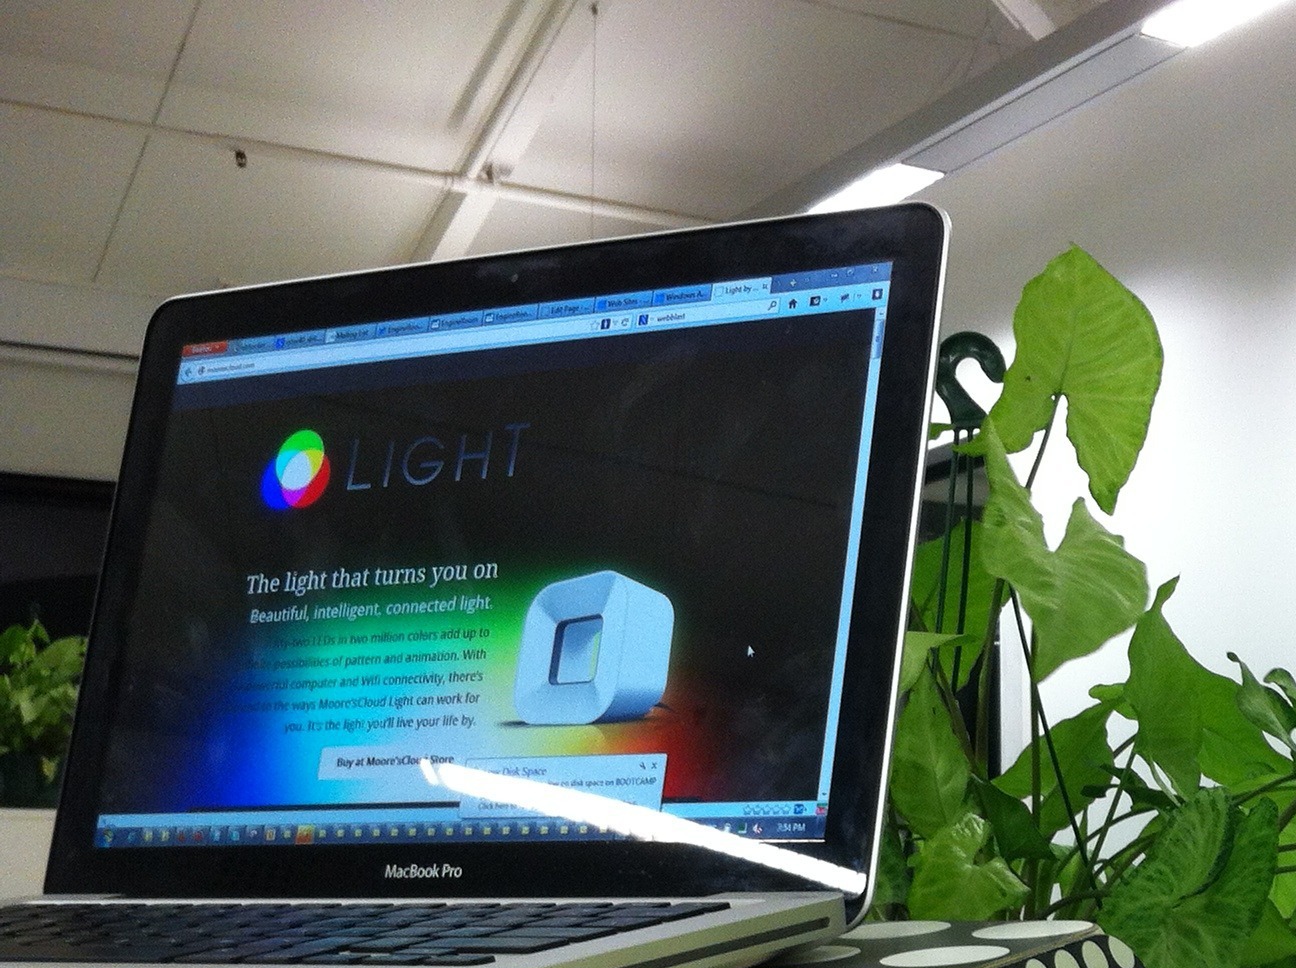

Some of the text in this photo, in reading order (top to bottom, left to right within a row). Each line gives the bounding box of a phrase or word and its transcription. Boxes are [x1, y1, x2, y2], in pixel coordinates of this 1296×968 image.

[347, 422, 531, 490] LIGHT
[247, 562, 499, 596] The light that turns you on
[250, 605, 310, 624] Beautiful,
[386, 597, 457, 616] connected
[459, 594, 493, 614] light.
[350, 635, 368, 645] two
[371, 631, 405, 643] million
[407, 630, 438, 642] colors
[441, 628, 461, 640] add
[463, 629, 477, 641] up
[479, 627, 490, 638] to
[332, 655, 344, 667] of
[345, 654, 382, 669] pattern
[384, 653, 403, 664] and
[405, 651, 459, 664] animation.
[462, 649, 487, 660] With
[292, 678, 336, 692] computer
[340, 676, 359, 688] and
[383, 672, 446, 687] connectivity,
[448, 670, 483, 684] there's
[389, 696, 414, 710] Light
[416, 696, 434, 706] can
[436, 692, 463, 705] work
[465, 692, 481, 704] for
[325, 720, 340, 731] the
[343, 718, 366, 734] light
[367, 717, 395, 732] you'll
[396, 716, 414, 728] live
[416, 717, 441, 731] your
[442, 715, 459, 727] life
[461, 714, 477, 729] by.
[336, 757, 353, 768] Buy
[355, 758, 364, 767] at
[430, 754, 455, 765] Store
[502, 766, 519, 776] Disk
[522, 766, 547, 779] Space
[585, 779, 604, 789] space
[605, 778, 615, 786] on
[615, 776, 657, 786] BOOTCAMP
[384, 863, 463, 879] MacBook Pro
